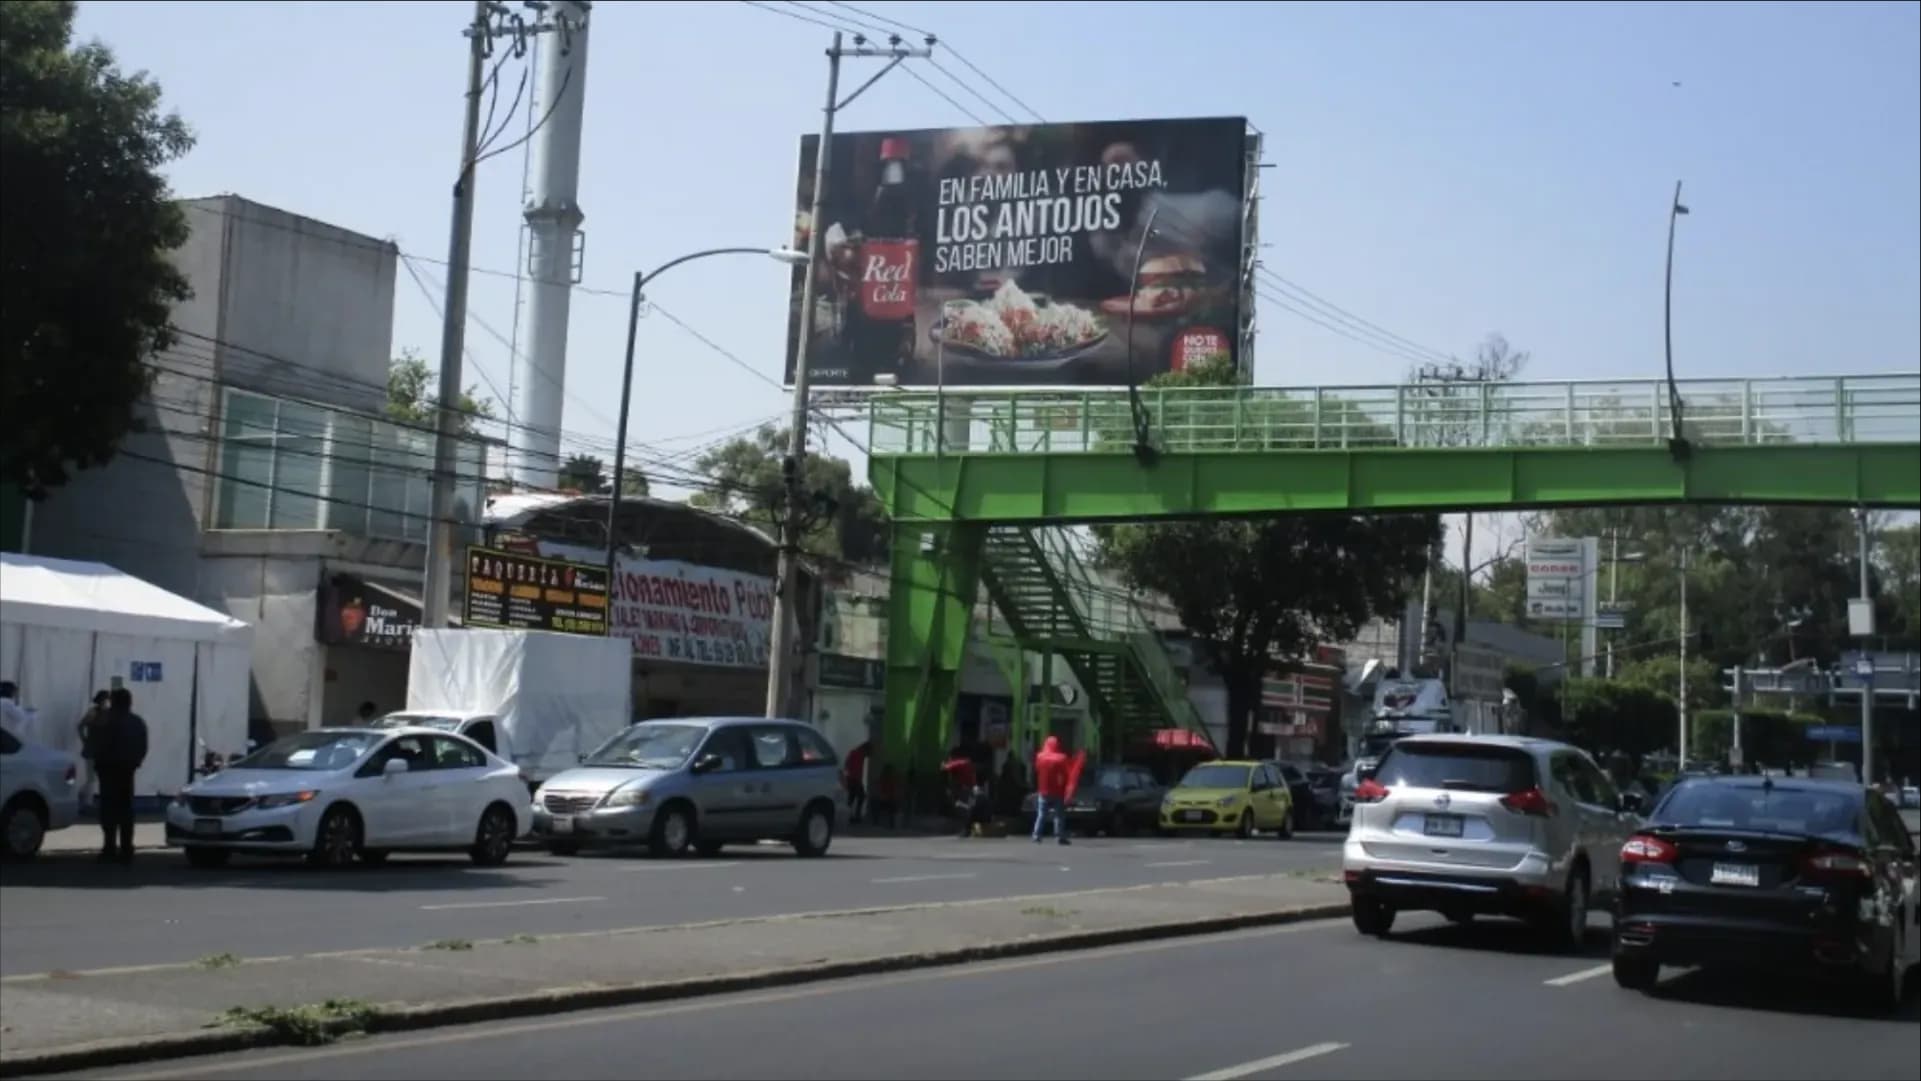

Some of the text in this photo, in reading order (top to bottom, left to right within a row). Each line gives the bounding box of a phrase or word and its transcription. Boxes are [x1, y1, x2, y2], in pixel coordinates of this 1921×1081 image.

[939, 177, 965, 205] EN
[970, 169, 1049, 202] FAMILIA
[1056, 167, 1070, 194] Y
[1074, 165, 1101, 193] EN
[936, 192, 1122, 244] LOS ANTOJOS
[863, 250, 912, 282] Red
[935, 236, 1073, 273] SABEN MEJOR
[872, 283, 906, 303] Cola
[370, 605, 398, 617] Don
